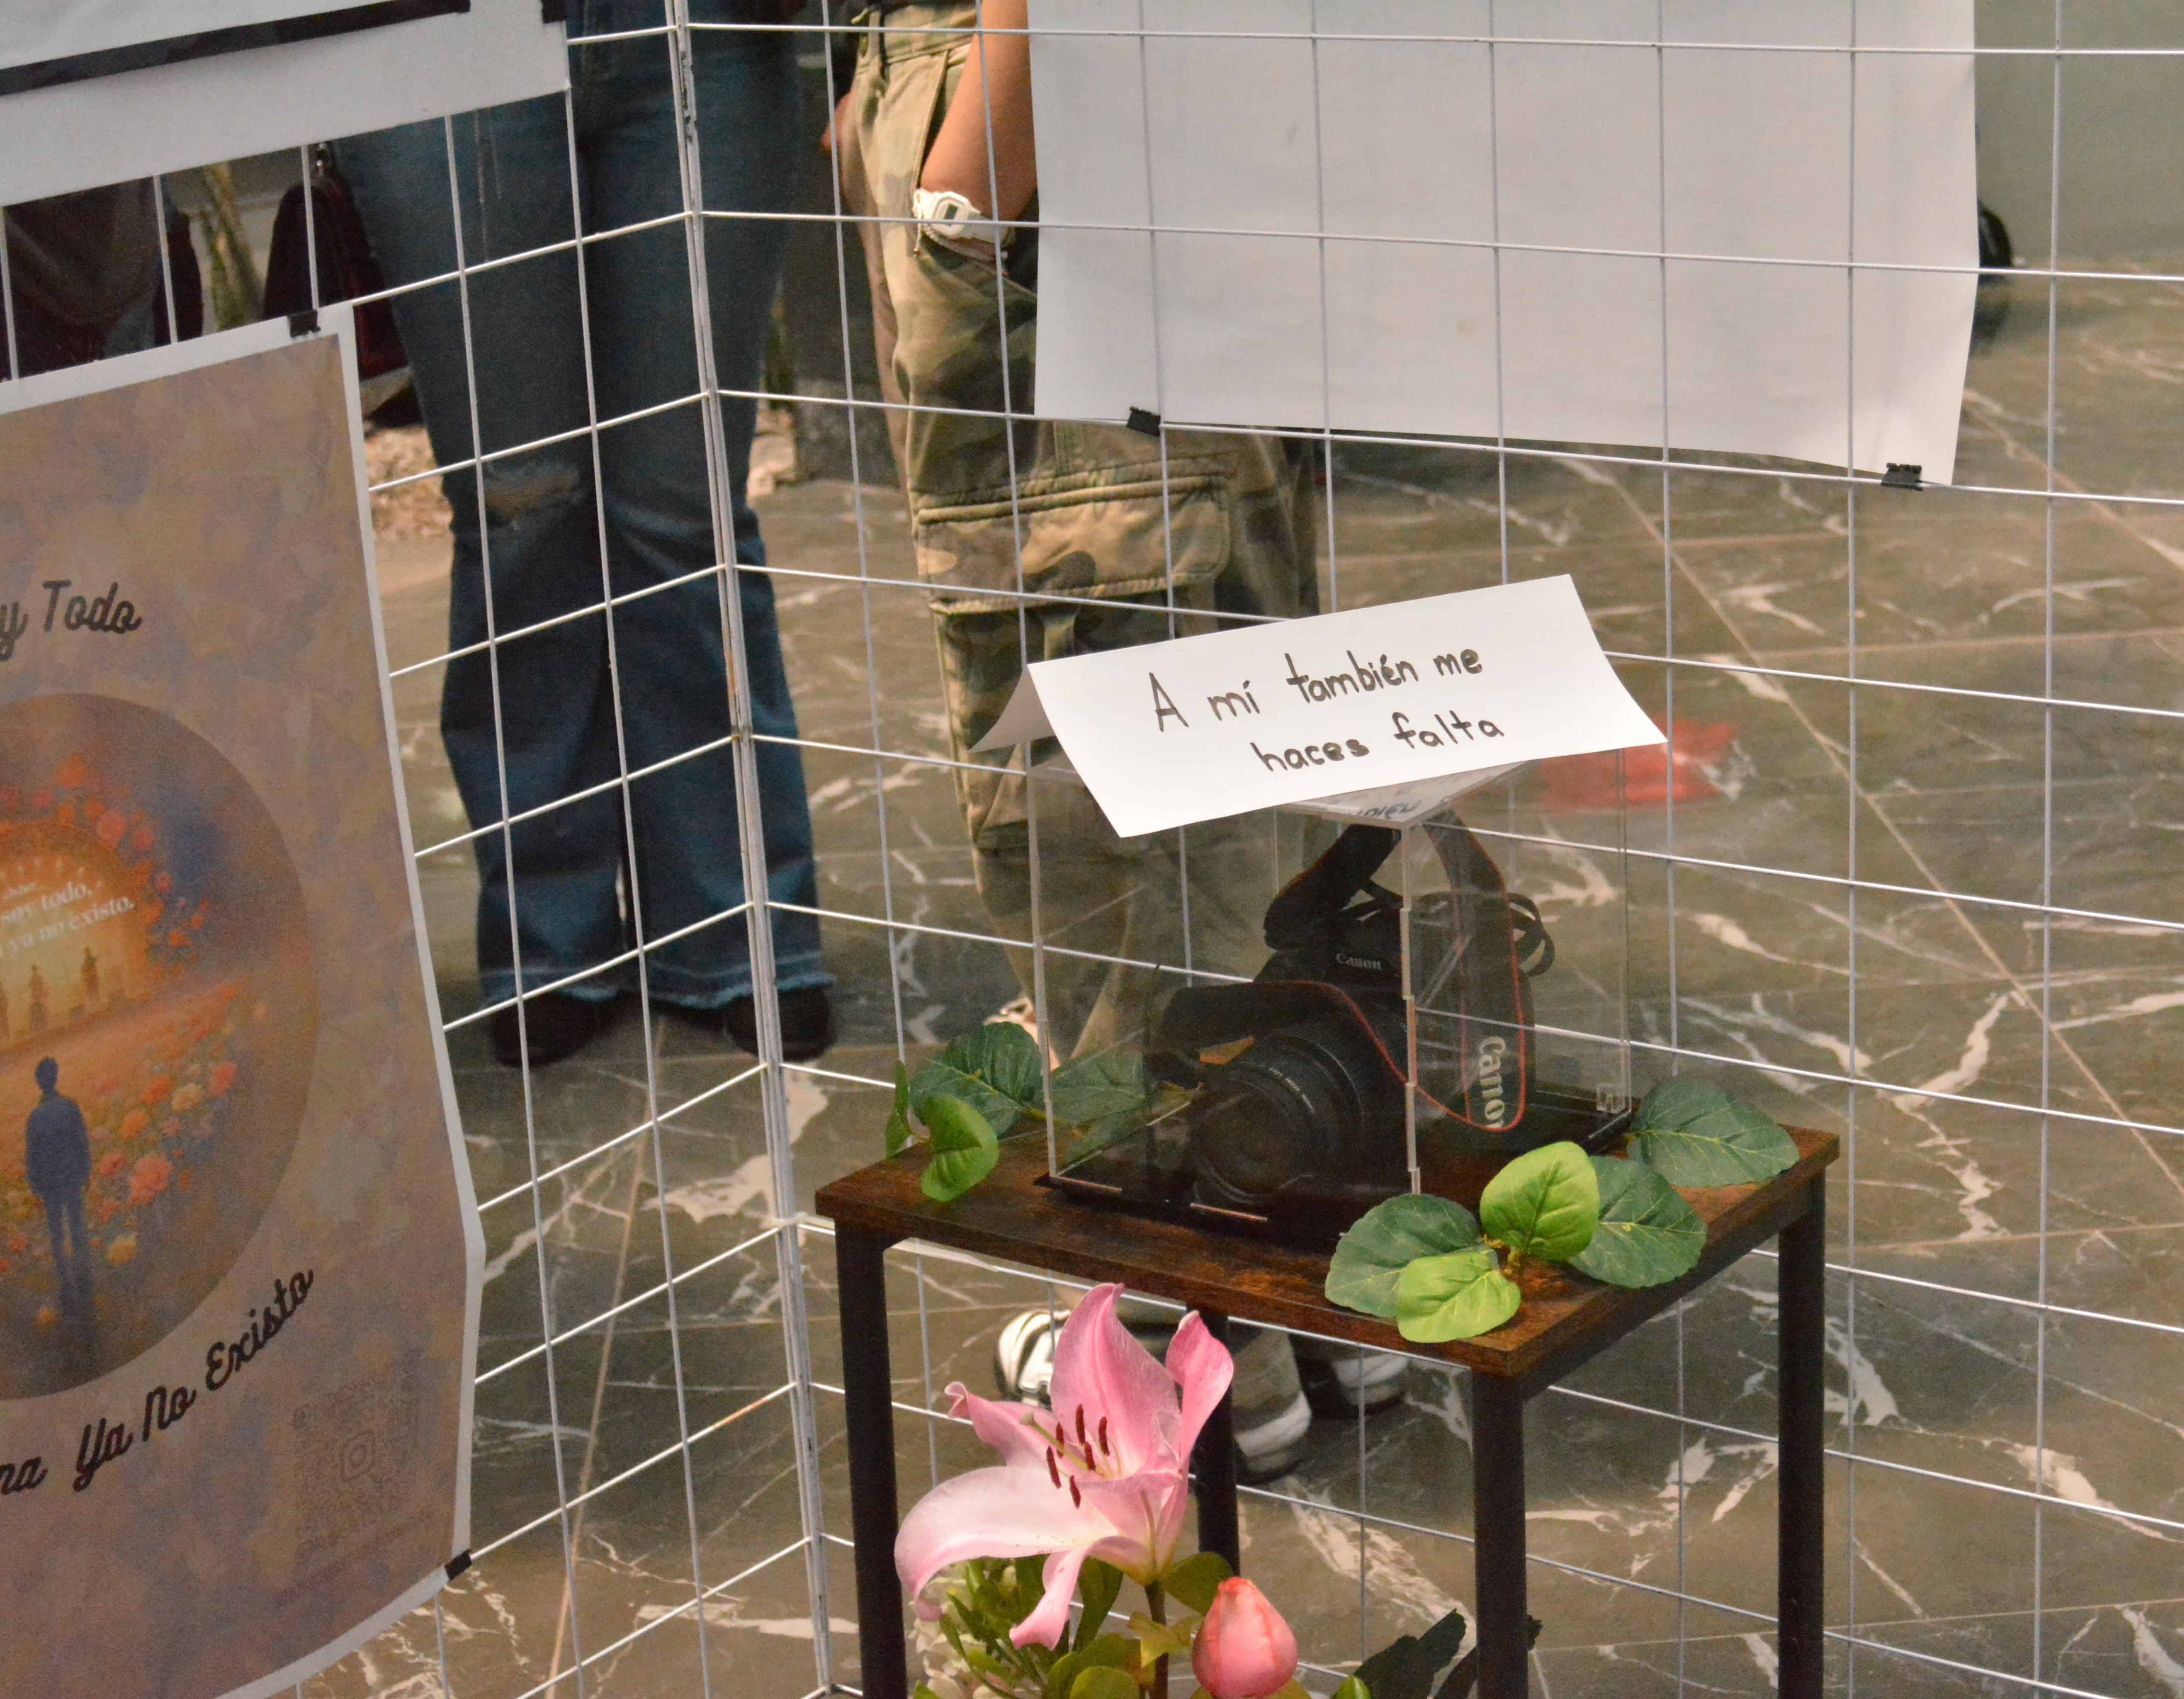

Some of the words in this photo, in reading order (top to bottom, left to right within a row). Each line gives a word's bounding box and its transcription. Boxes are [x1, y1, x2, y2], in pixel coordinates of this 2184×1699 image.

[42, 580, 142, 633] Todo
[1149, 672, 1189, 732] A
[1207, 680, 1260, 721] mí
[1284, 650, 1419, 703] también
[1433, 649, 1483, 677] me
[1250, 739, 1370, 771] haces
[1392, 710, 1504, 747] falta
[1336, 953, 1382, 970] Canon
[73, 1418, 133, 1492] Ya
[142, 1386, 197, 1442] No
[205, 1269, 314, 1390] Existo
